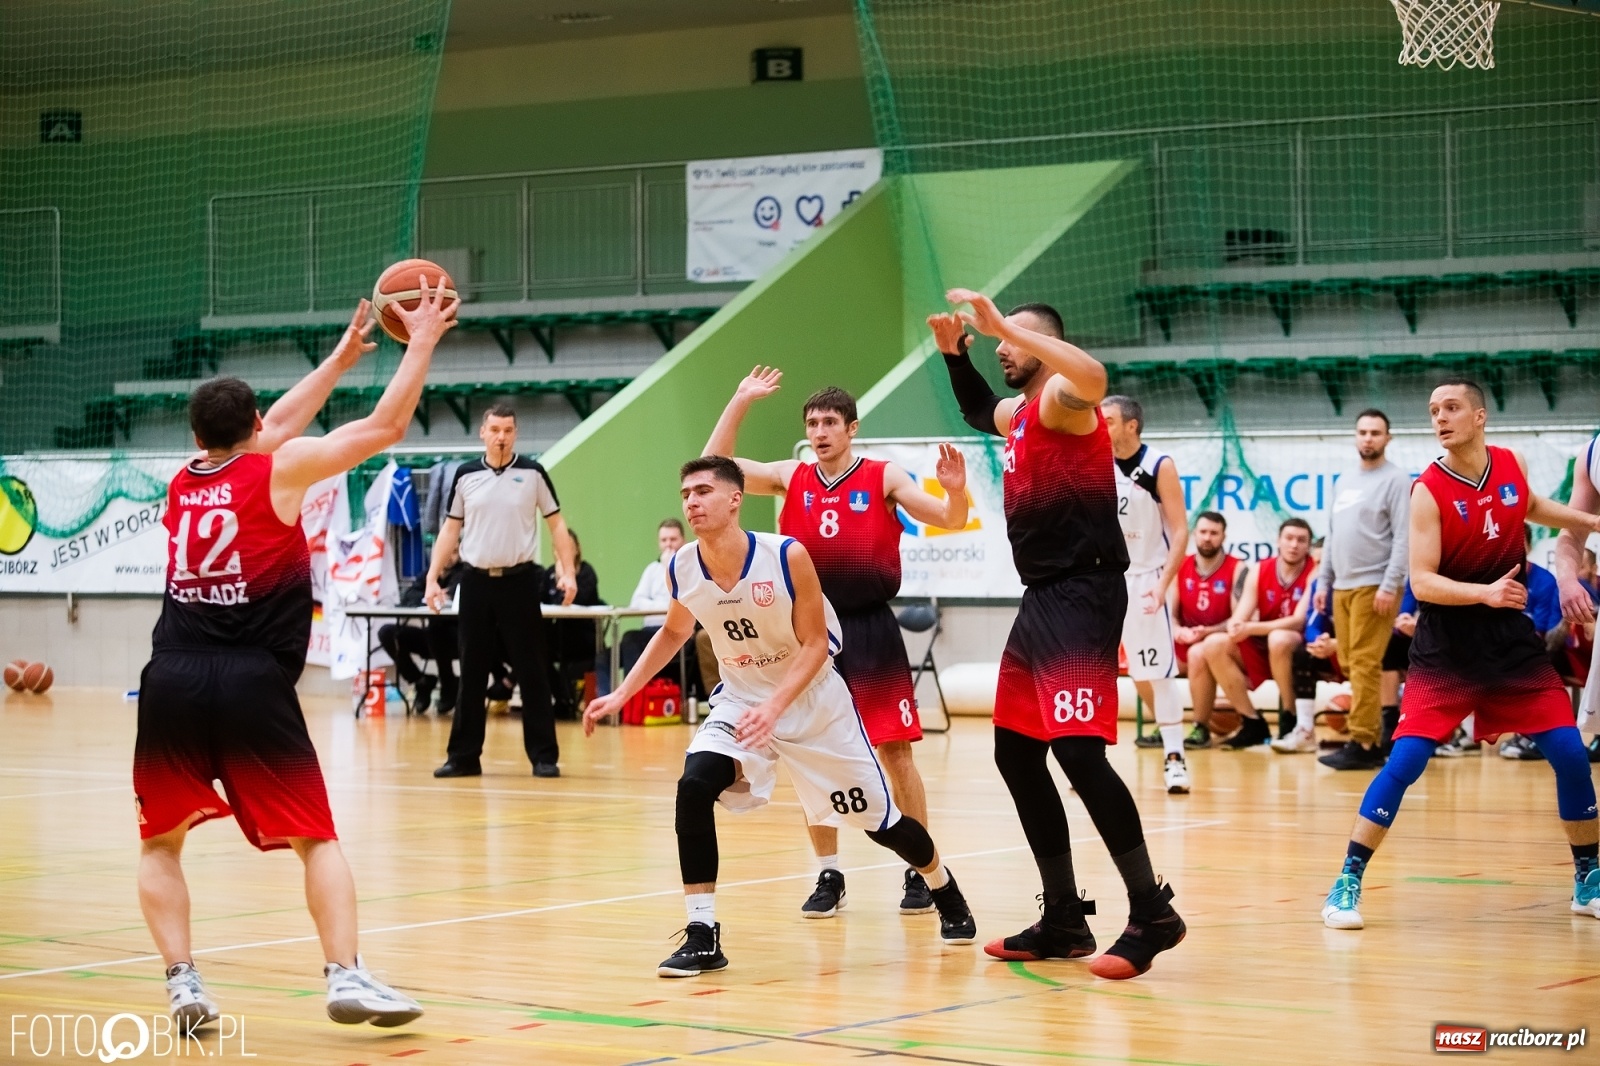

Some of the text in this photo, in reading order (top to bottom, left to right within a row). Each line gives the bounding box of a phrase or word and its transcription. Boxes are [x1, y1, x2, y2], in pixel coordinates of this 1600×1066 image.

[767, 59, 793, 78] B
[1218, 474, 1341, 511] RACI
[1477, 495, 1493, 506] UFO
[51, 501, 168, 568] JEST W PORZ
[819, 509, 840, 539] 8
[1482, 508, 1500, 541] 4
[171, 508, 242, 581] 12
[901, 542, 986, 562] raciborski
[723, 617, 760, 642] 88
[1137, 648, 1159, 667] 12
[898, 698, 914, 728] 8
[1054, 687, 1095, 723] 85
[830, 786, 868, 815] 88
